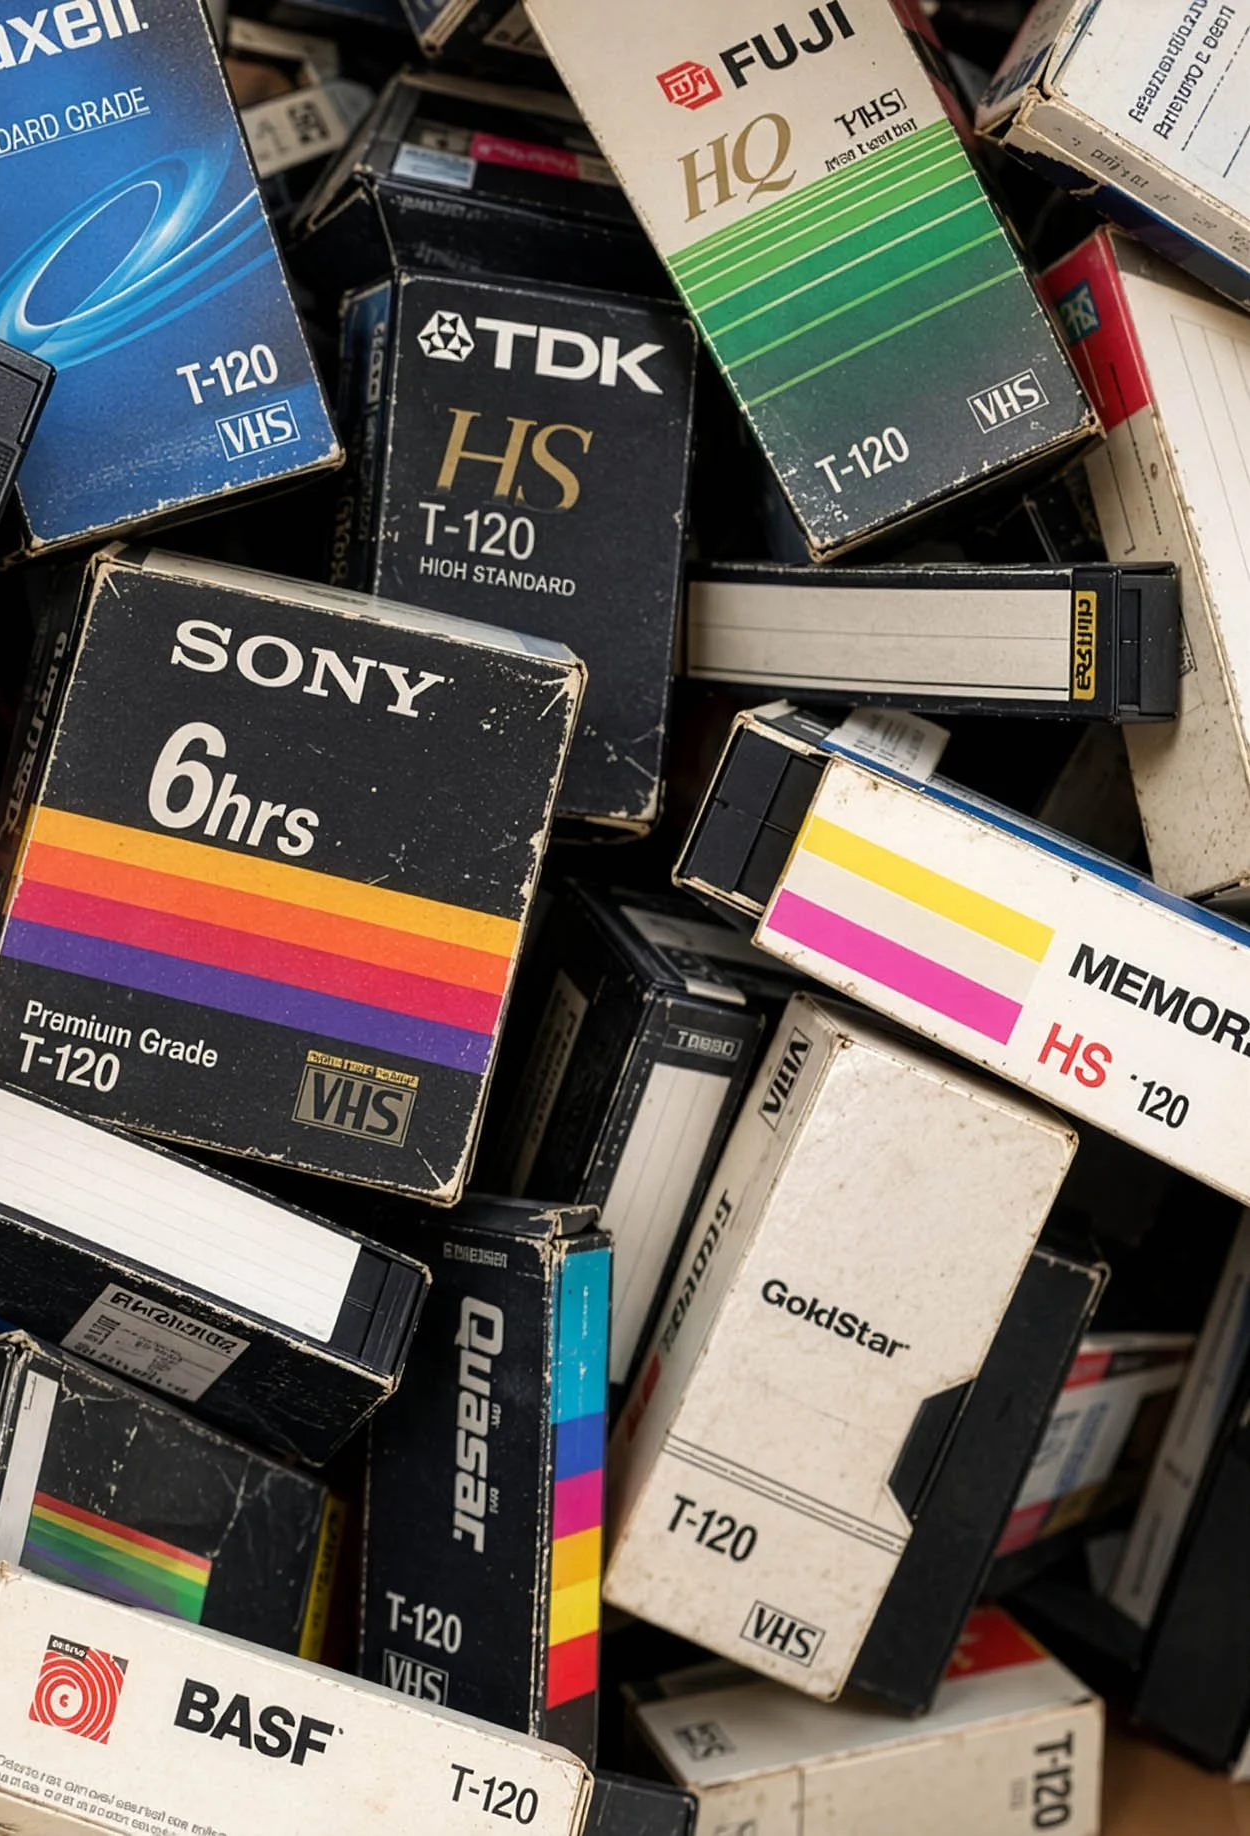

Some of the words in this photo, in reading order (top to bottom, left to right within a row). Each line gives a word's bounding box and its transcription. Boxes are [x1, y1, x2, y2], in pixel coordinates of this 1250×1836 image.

[719, 0, 855, 89] FUJI
[65, 87, 150, 132] GRADE
[678, 112, 797, 223] HQ
[175, 344, 278, 405] T-120
[475, 316, 665, 395] TDK
[221, 406, 292, 454] VHS
[973, 374, 1040, 426] VHS
[436, 407, 594, 511] HS
[814, 426, 910, 494] T-120
[418, 501, 535, 561] T-120
[472, 565, 576, 597] STANDARD
[170, 619, 446, 718] SONY
[149, 721, 320, 857] 6hrs
[1068, 942, 1250, 1060] MEMOR
[19, 1031, 121, 1093] T-120
[139, 1027, 219, 1069] Grade
[1037, 1021, 1113, 1089] HS
[313, 1071, 404, 1137] VHS
[454, 1295, 505, 1554] Quasar
[667, 1494, 758, 1563] T-120
[385, 1590, 463, 1654] T-120
[753, 1606, 817, 1660] VHS
[388, 1655, 443, 1704] VHS
[174, 1677, 335, 1766] BASF
[449, 1762, 539, 1826] T-120
[1033, 1729, 1075, 1832] T-120
